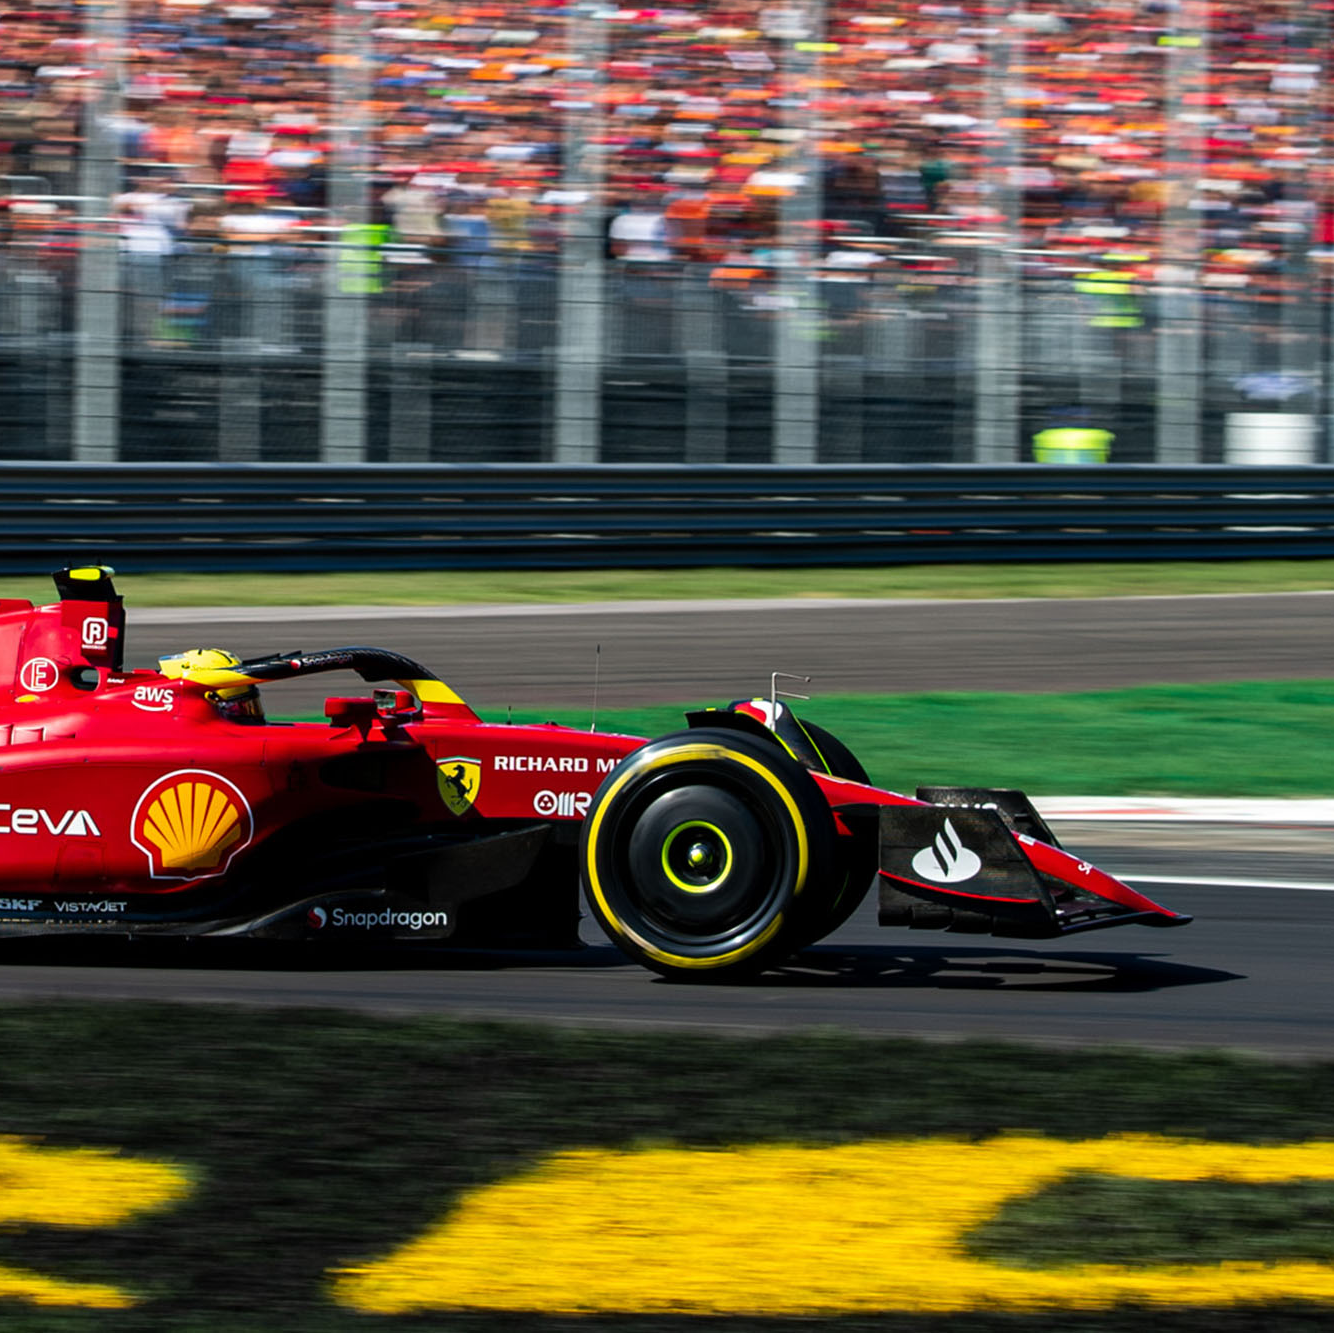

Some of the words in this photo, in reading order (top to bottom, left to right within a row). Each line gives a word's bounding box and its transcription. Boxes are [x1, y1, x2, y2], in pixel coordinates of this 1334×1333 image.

[134, 686, 174, 704] aws
[494, 756, 589, 772] RICHARD
[332, 908, 447, 931] Snapdragon
